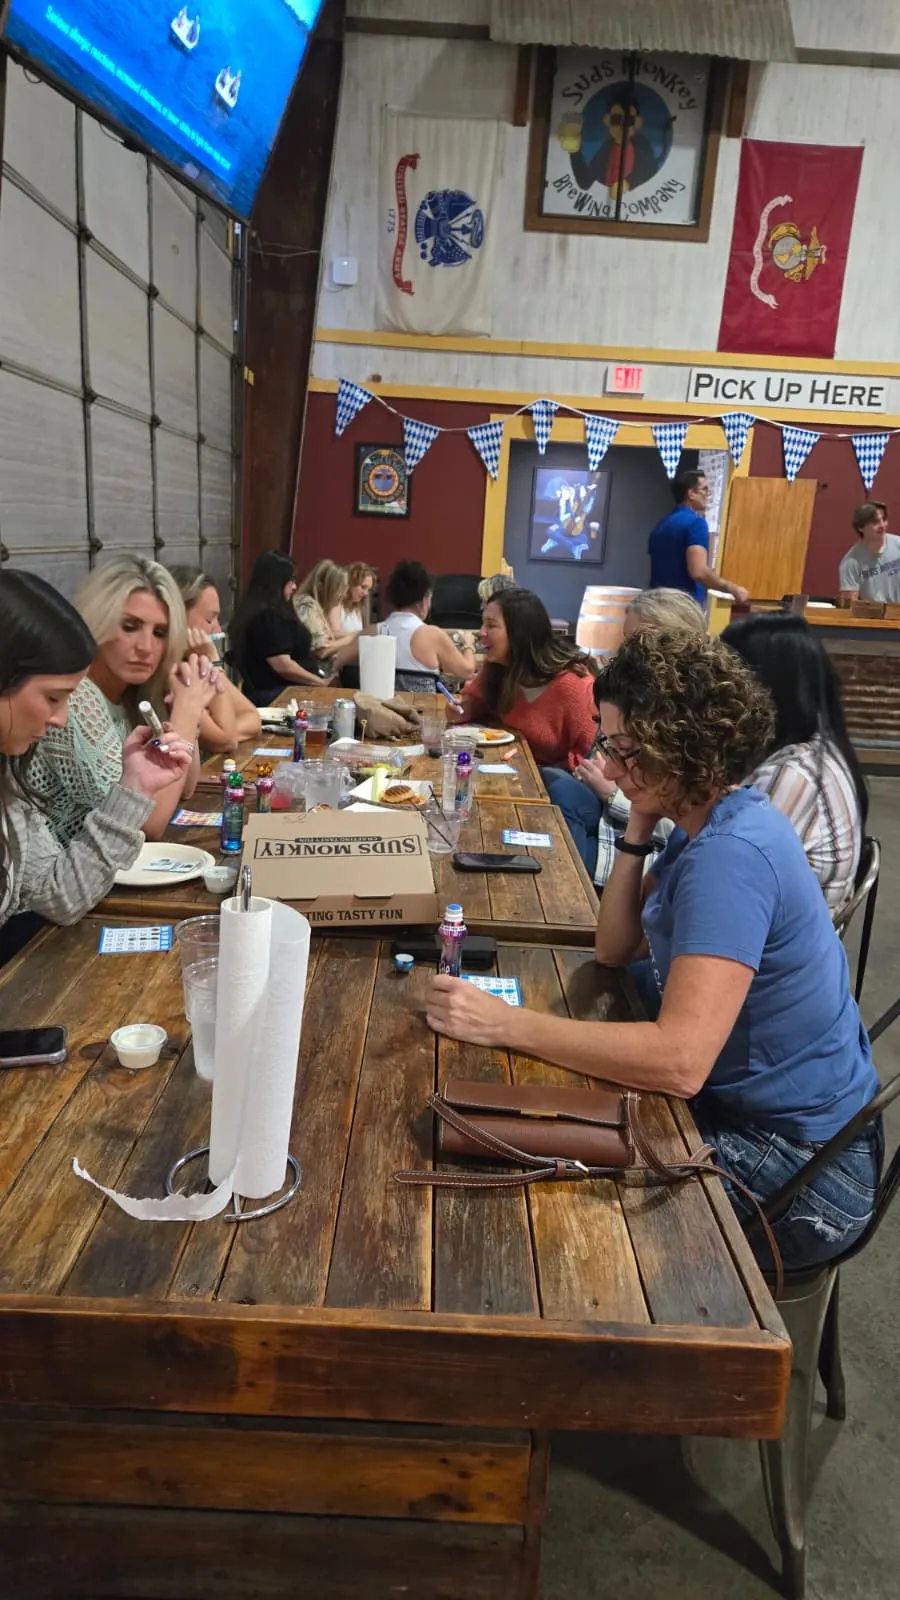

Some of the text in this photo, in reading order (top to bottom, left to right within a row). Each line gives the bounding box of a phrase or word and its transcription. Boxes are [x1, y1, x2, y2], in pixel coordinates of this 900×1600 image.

[387, 208, 396, 233] 1775
[615, 367, 644, 389] EXIT
[693, 373, 885, 407] PICK UP HERE
[260, 838, 416, 856] SUDS MONKEY
[301, 908, 403, 921] TING TASTY FUN
